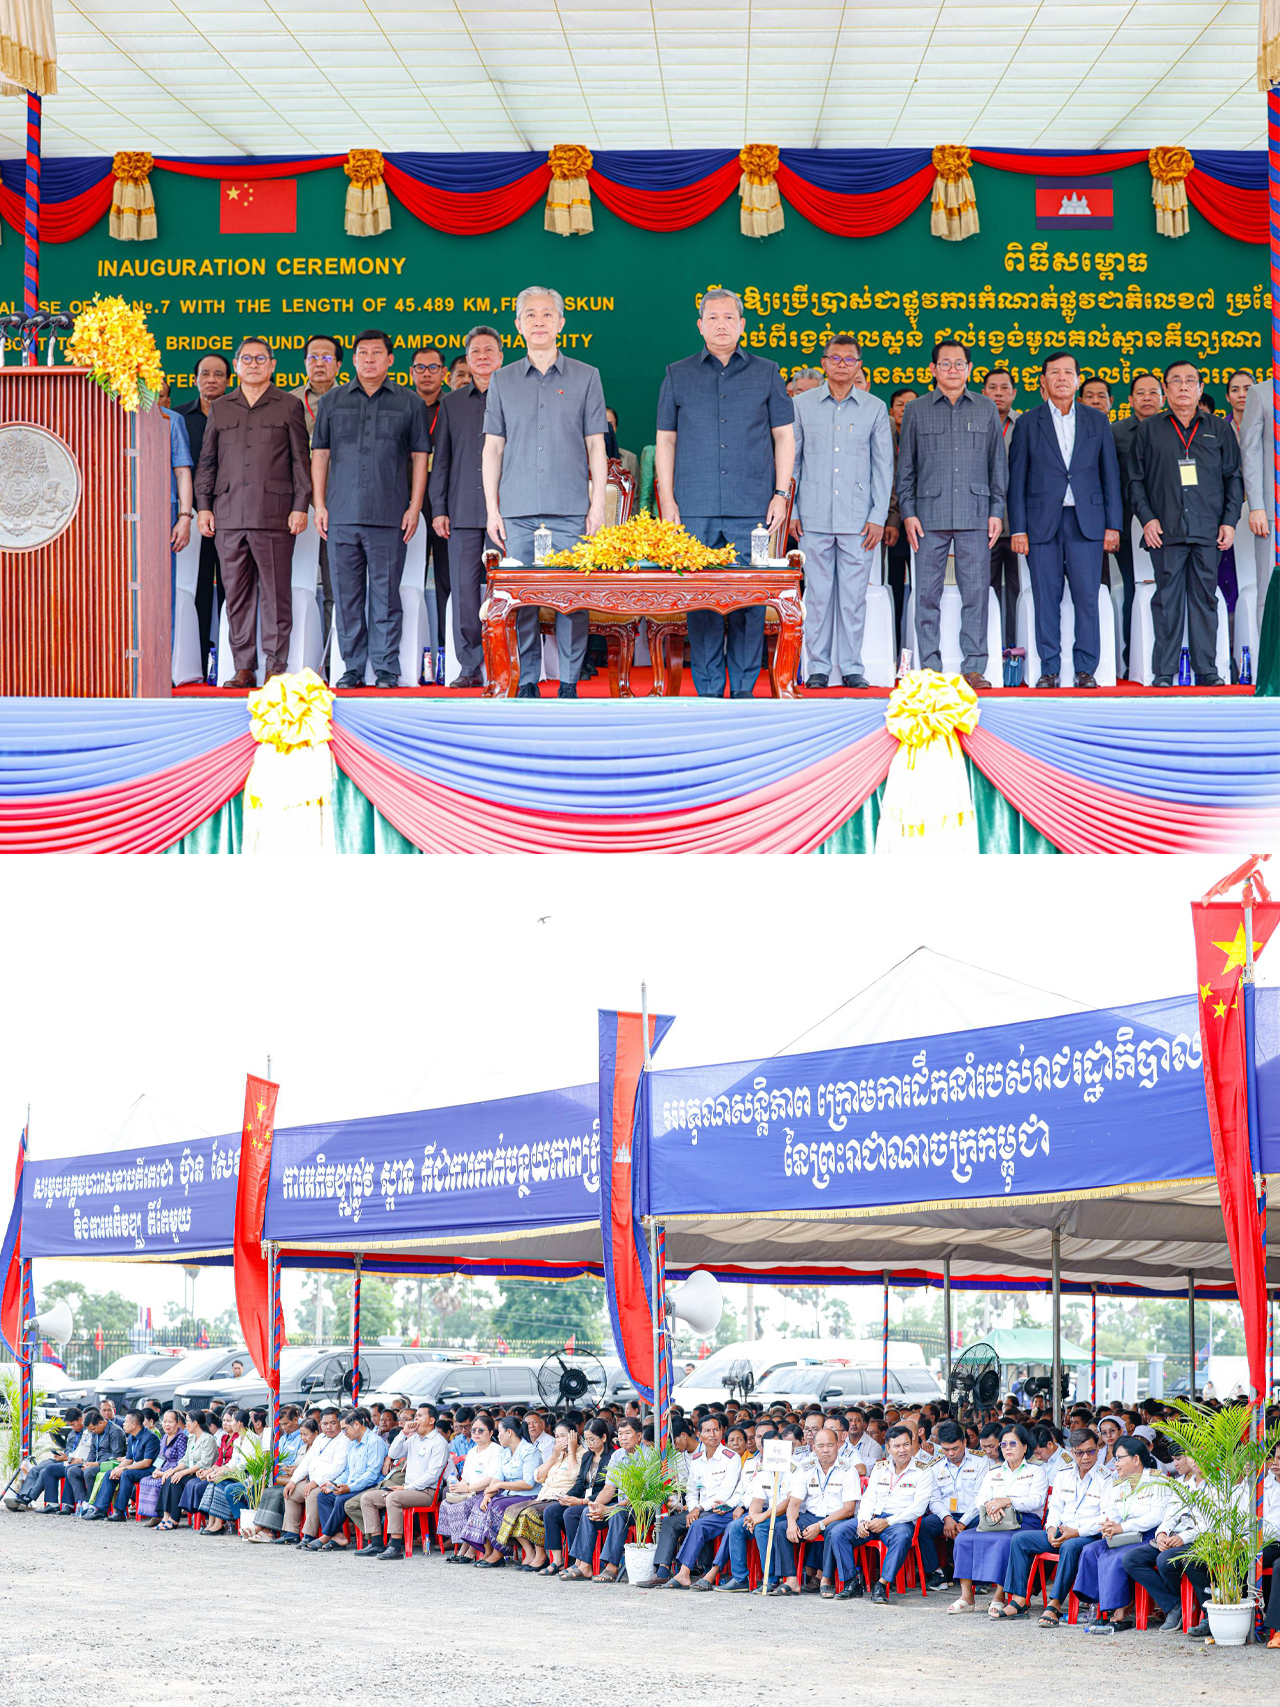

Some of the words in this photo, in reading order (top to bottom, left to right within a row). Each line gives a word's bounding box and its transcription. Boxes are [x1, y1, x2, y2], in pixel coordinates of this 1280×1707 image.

[98, 258, 266, 277] INAUGURATION
[276, 257, 406, 275] CEREMONY
[1004, 241, 1148, 281] ពិធីសម្ពោធ
[38, 300, 61, 314] SE
[180, 299, 225, 314] WITH
[235, 299, 271, 313] THE
[282, 298, 353, 313] LENGTH
[362, 298, 387, 312] OF
[394, 297, 454, 312] 45.489
[564, 296, 614, 311] SKUN
[166, 335, 233, 350] BRIDGE
[663, 1076, 811, 1146] អរគុណសន្តិភាព
[781, 1113, 1050, 1193] នៃព្រះរាជាណាចក្រកម្ពុជា
[380, 1157, 415, 1211] ស្ពាន
